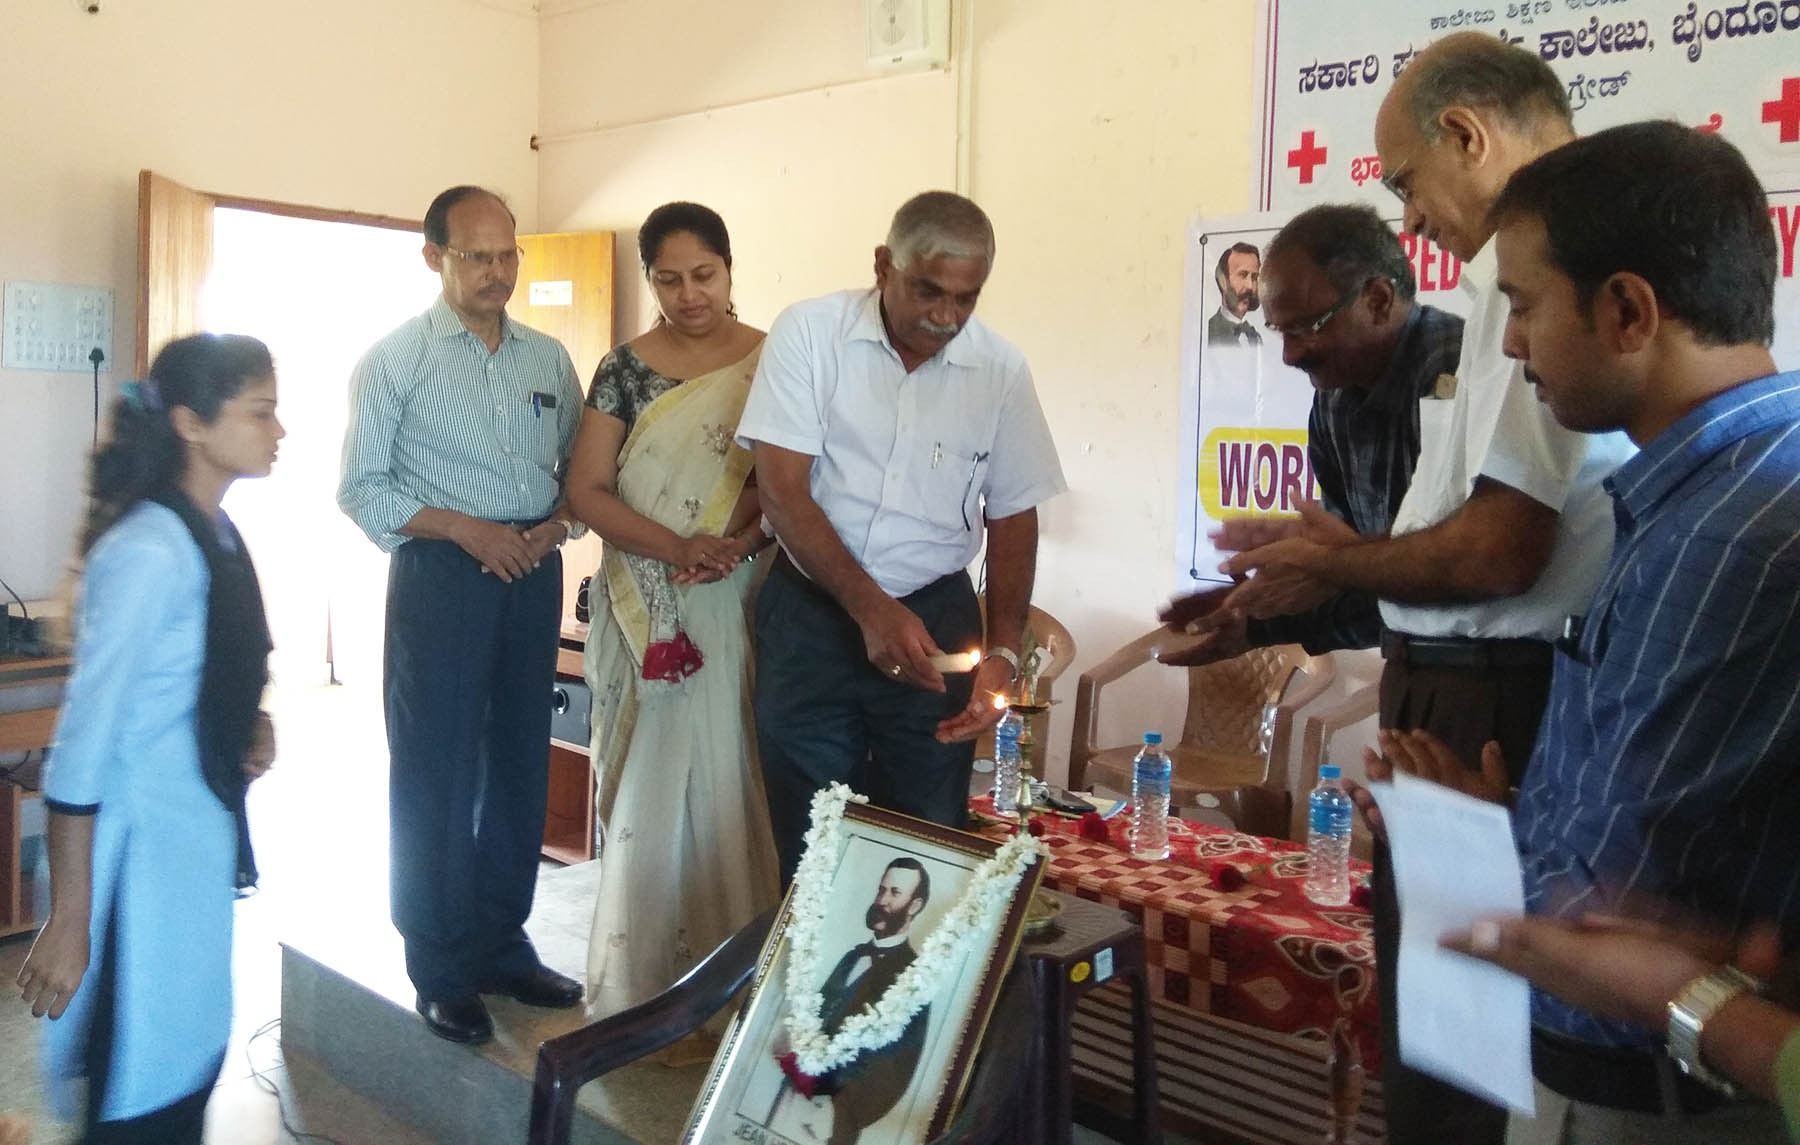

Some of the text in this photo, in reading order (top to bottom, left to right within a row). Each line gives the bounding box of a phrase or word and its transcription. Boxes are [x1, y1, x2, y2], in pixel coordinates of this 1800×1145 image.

[1299, 54, 1380, 93] ಸರ್ಕಾರಿ
[1539, 16, 1654, 61] ಕಾಲೇಜು,
[1672, 0, 1800, 62] ಬೈಂದೂರ
[1431, 8, 1496, 30] ಕಾಲೇಜು
[1219, 443, 1320, 510] WORL
